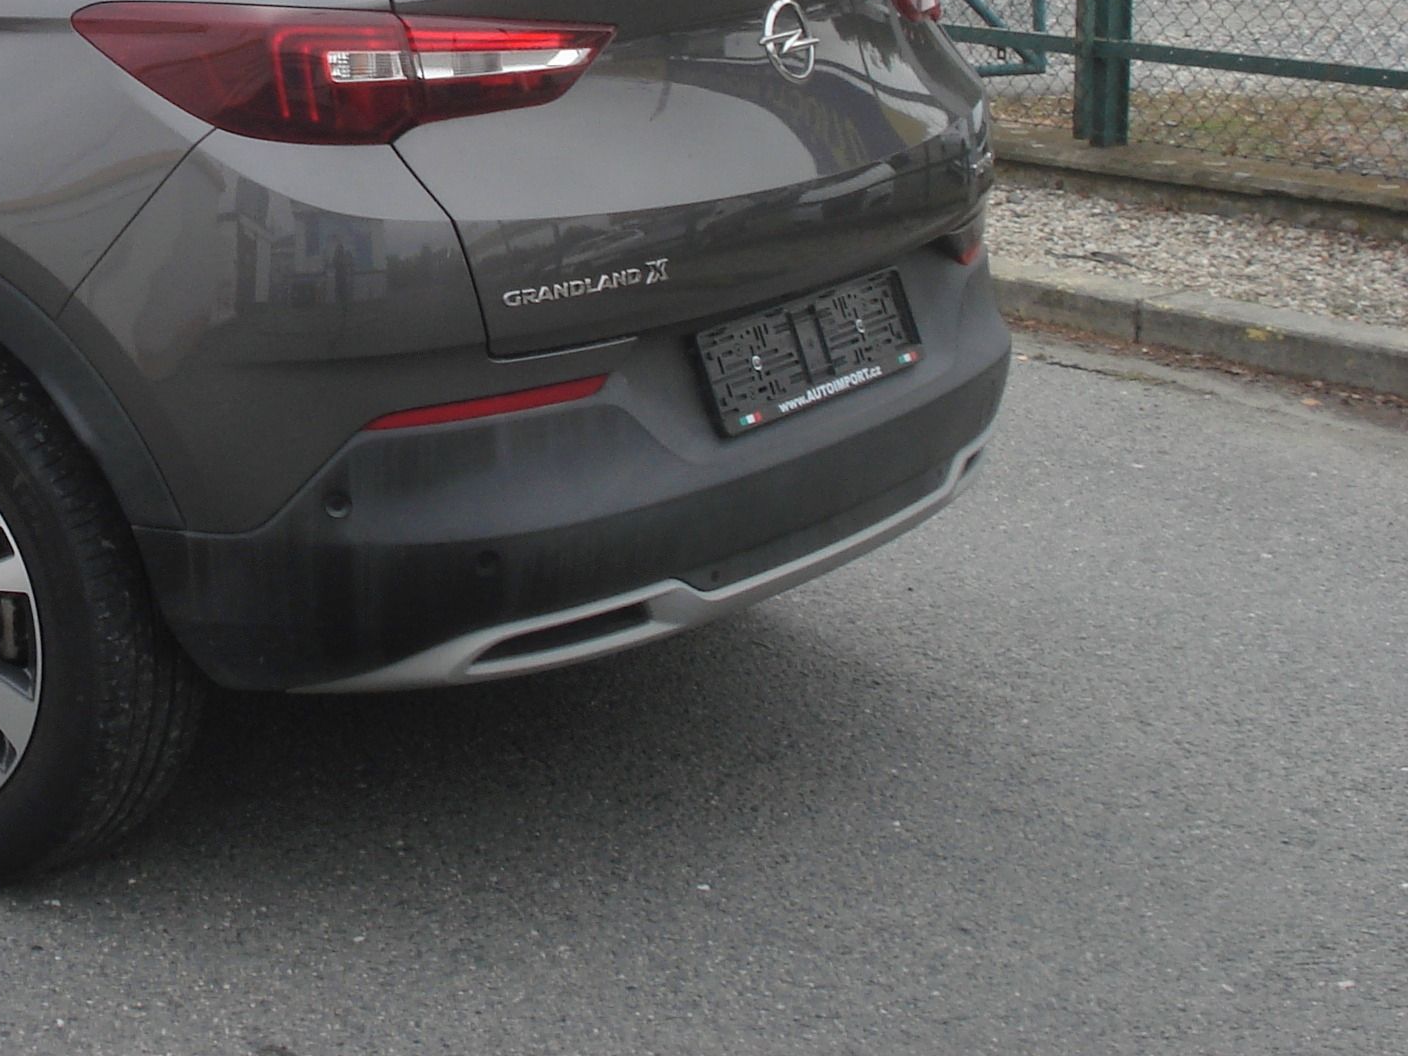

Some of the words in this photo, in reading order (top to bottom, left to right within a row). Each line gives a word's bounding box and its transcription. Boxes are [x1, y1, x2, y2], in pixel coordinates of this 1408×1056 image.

[502, 268, 641, 307] GRANDLAND
[645, 258, 669, 285] X
[778, 365, 883, 413] www.AUTOIMPORT.cz
